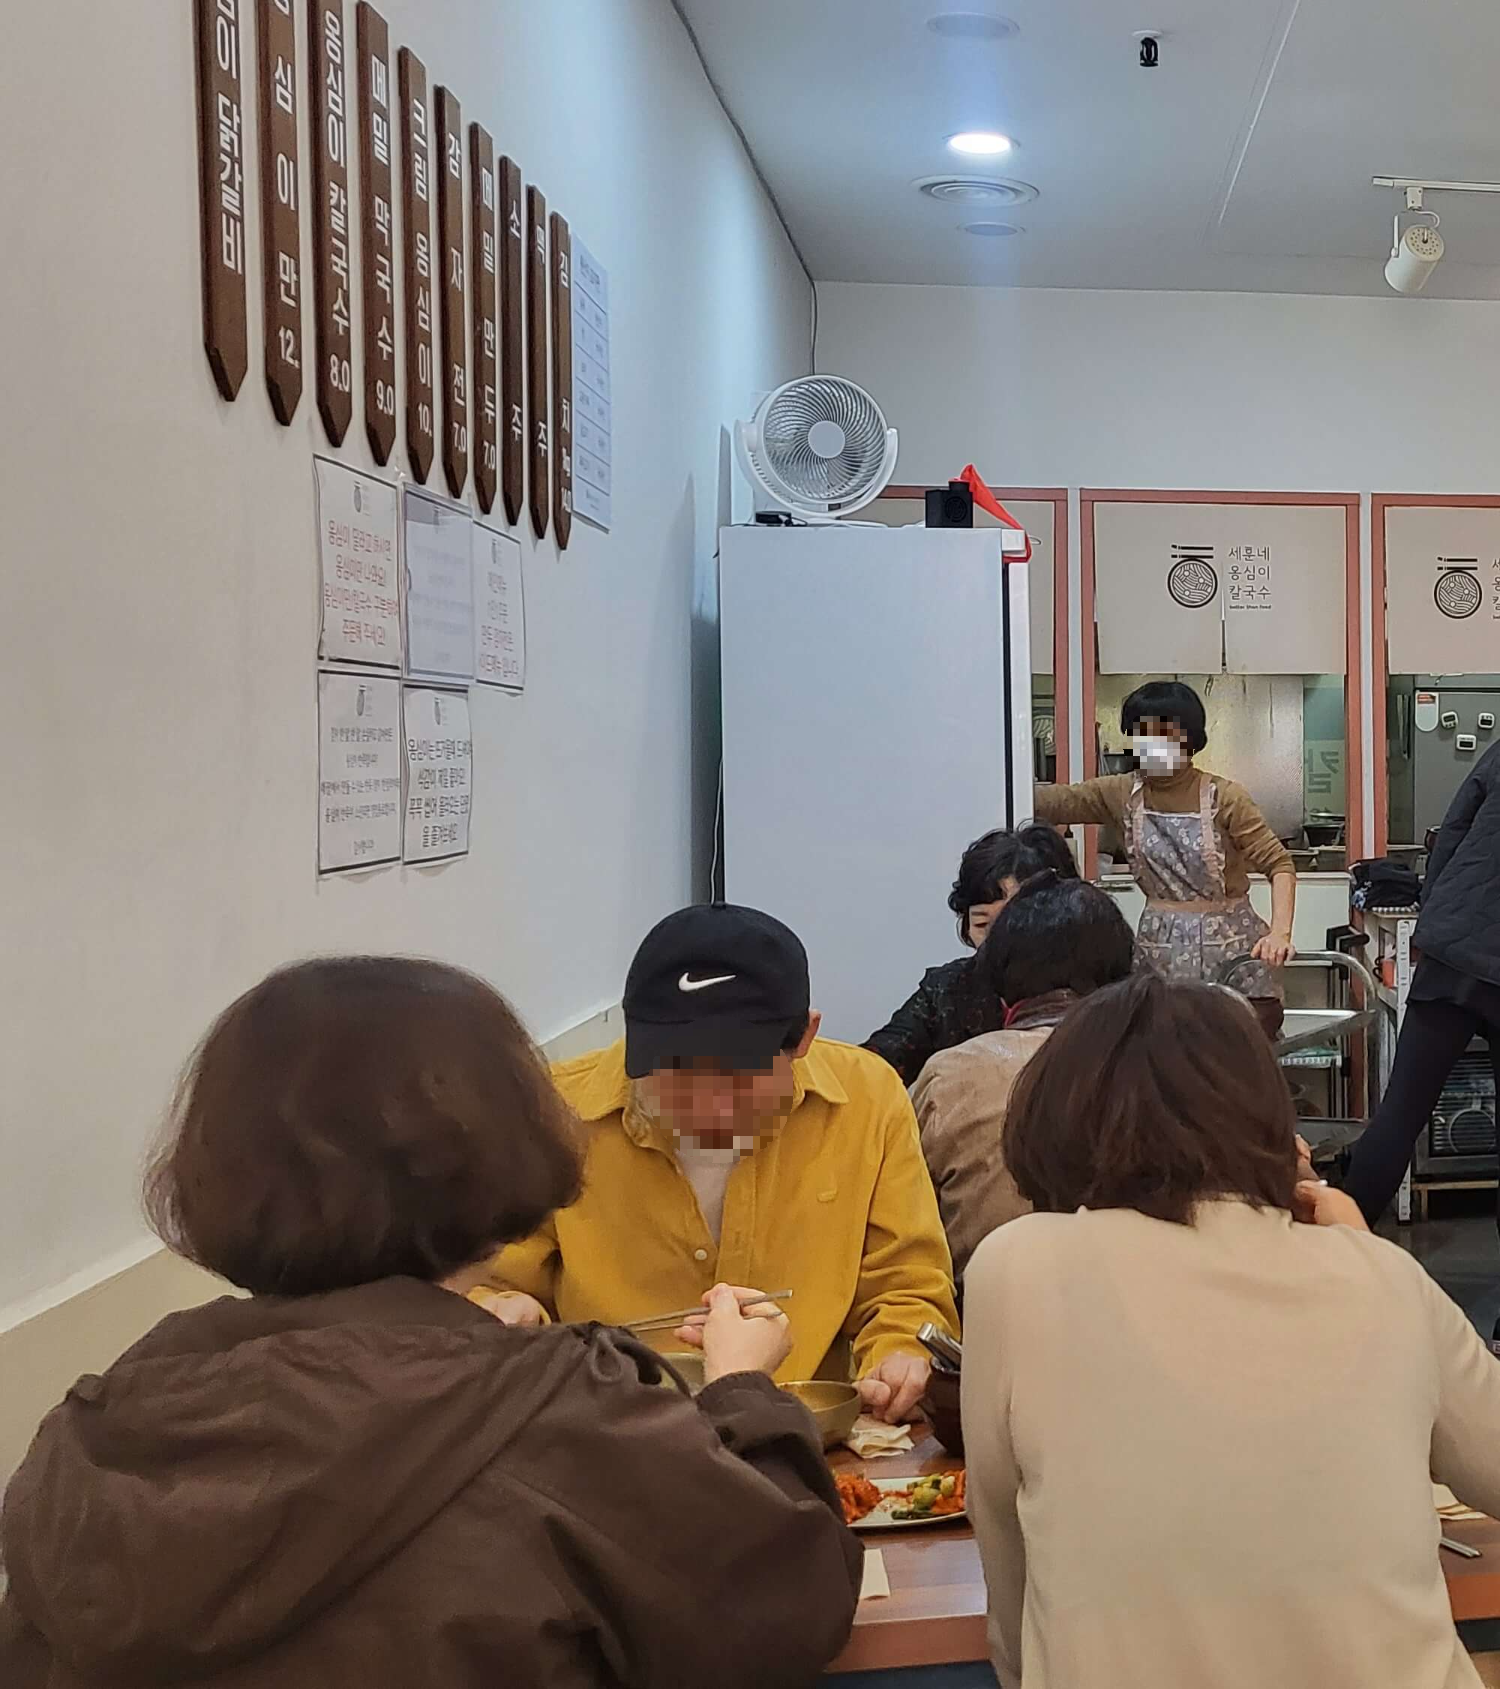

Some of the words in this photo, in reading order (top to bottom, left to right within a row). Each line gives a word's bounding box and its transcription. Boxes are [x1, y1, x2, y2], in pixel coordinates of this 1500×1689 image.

[324, 9, 345, 169] 옹심이
[217, 92, 242, 275] 닭갈비
[329, 181, 349, 335] 칼국수
[448, 131, 465, 408] 감자전
[415, 231, 431, 389] 옹심이
[509, 198, 523, 441] 소주
[330, 354, 350, 394] 8.0
[376, 379, 394, 417] 9.0
[453, 421, 467, 455] 7.0
[482, 440, 496, 472] 7.0
[1228, 546, 1270, 561] 세훈네
[1228, 565, 1270, 581] 옹심이
[1229, 584, 1271, 600] 칼국수
